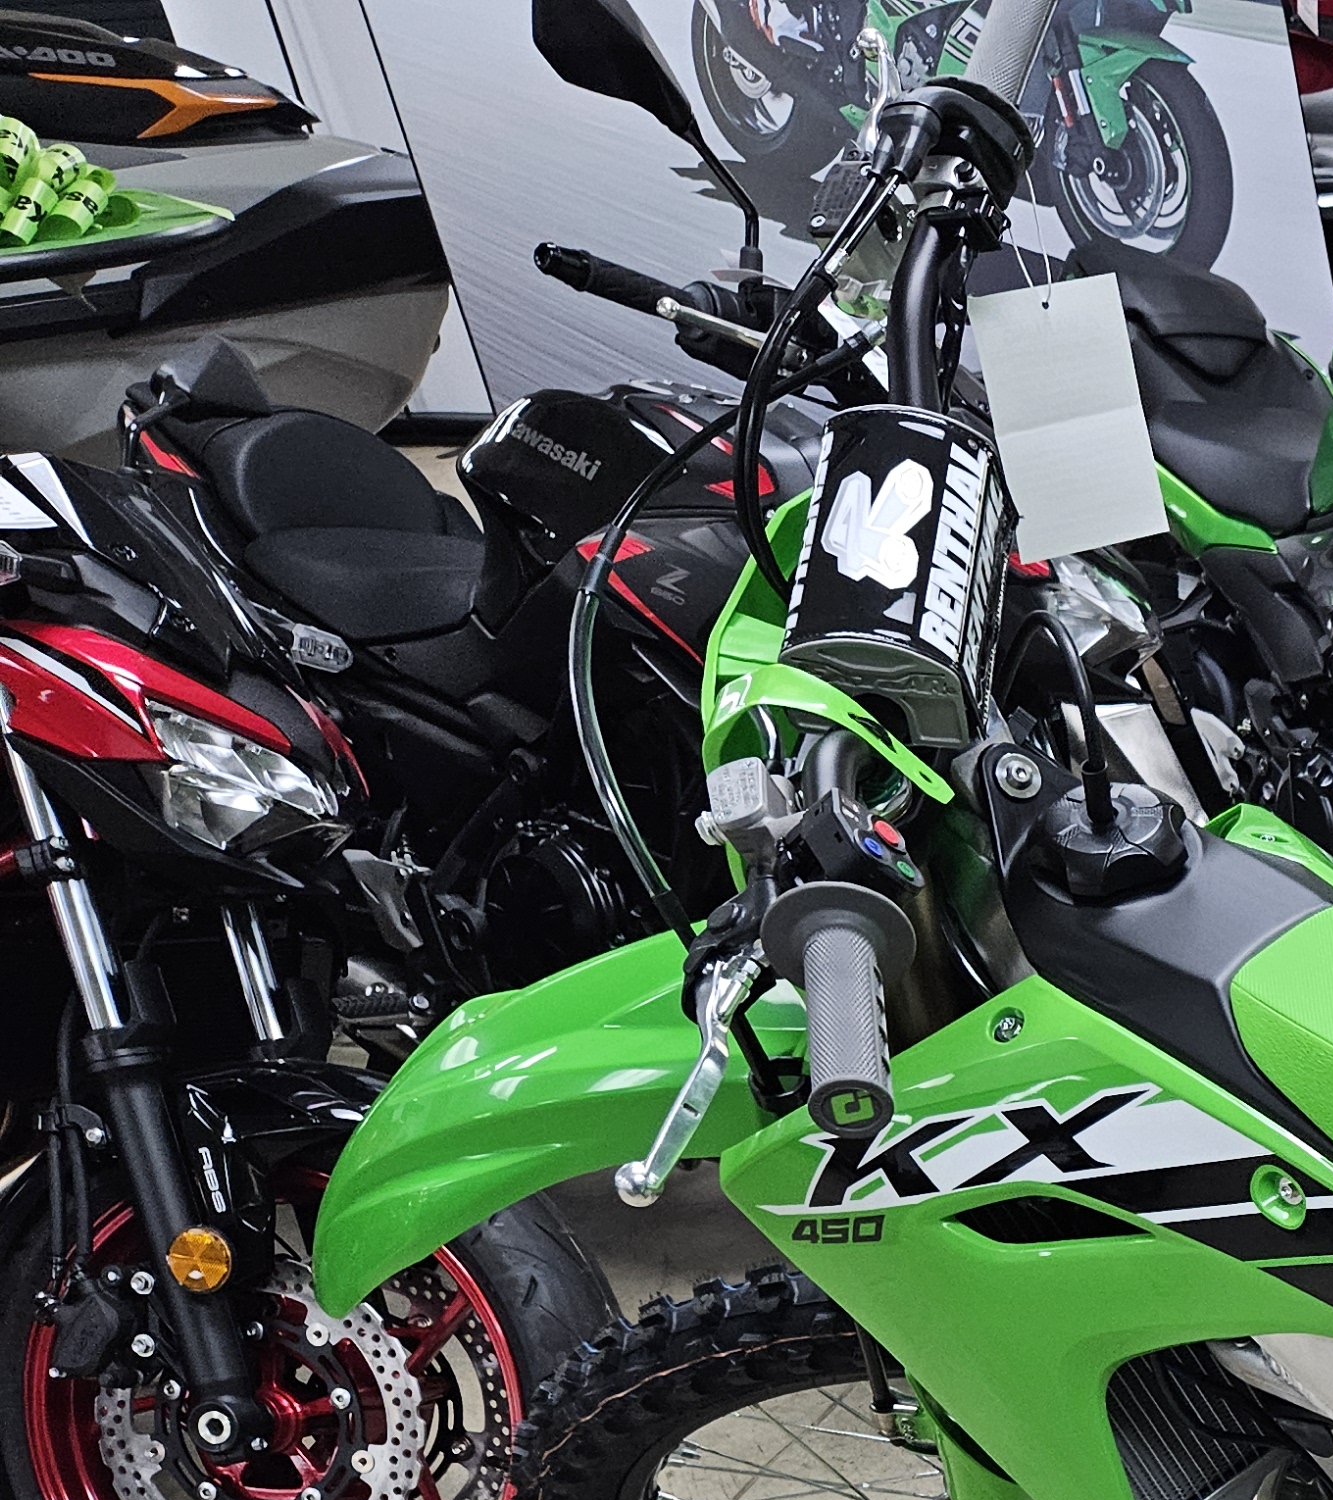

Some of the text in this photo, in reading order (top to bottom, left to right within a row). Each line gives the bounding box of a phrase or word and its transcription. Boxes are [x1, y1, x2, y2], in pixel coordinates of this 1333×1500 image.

[511, 421, 602, 481] awasaki
[919, 442, 989, 667] RENTHAL
[198, 1146, 226, 1213] ABS
[804, 1086, 1152, 1208] KX
[791, 1214, 886, 1244] 450
